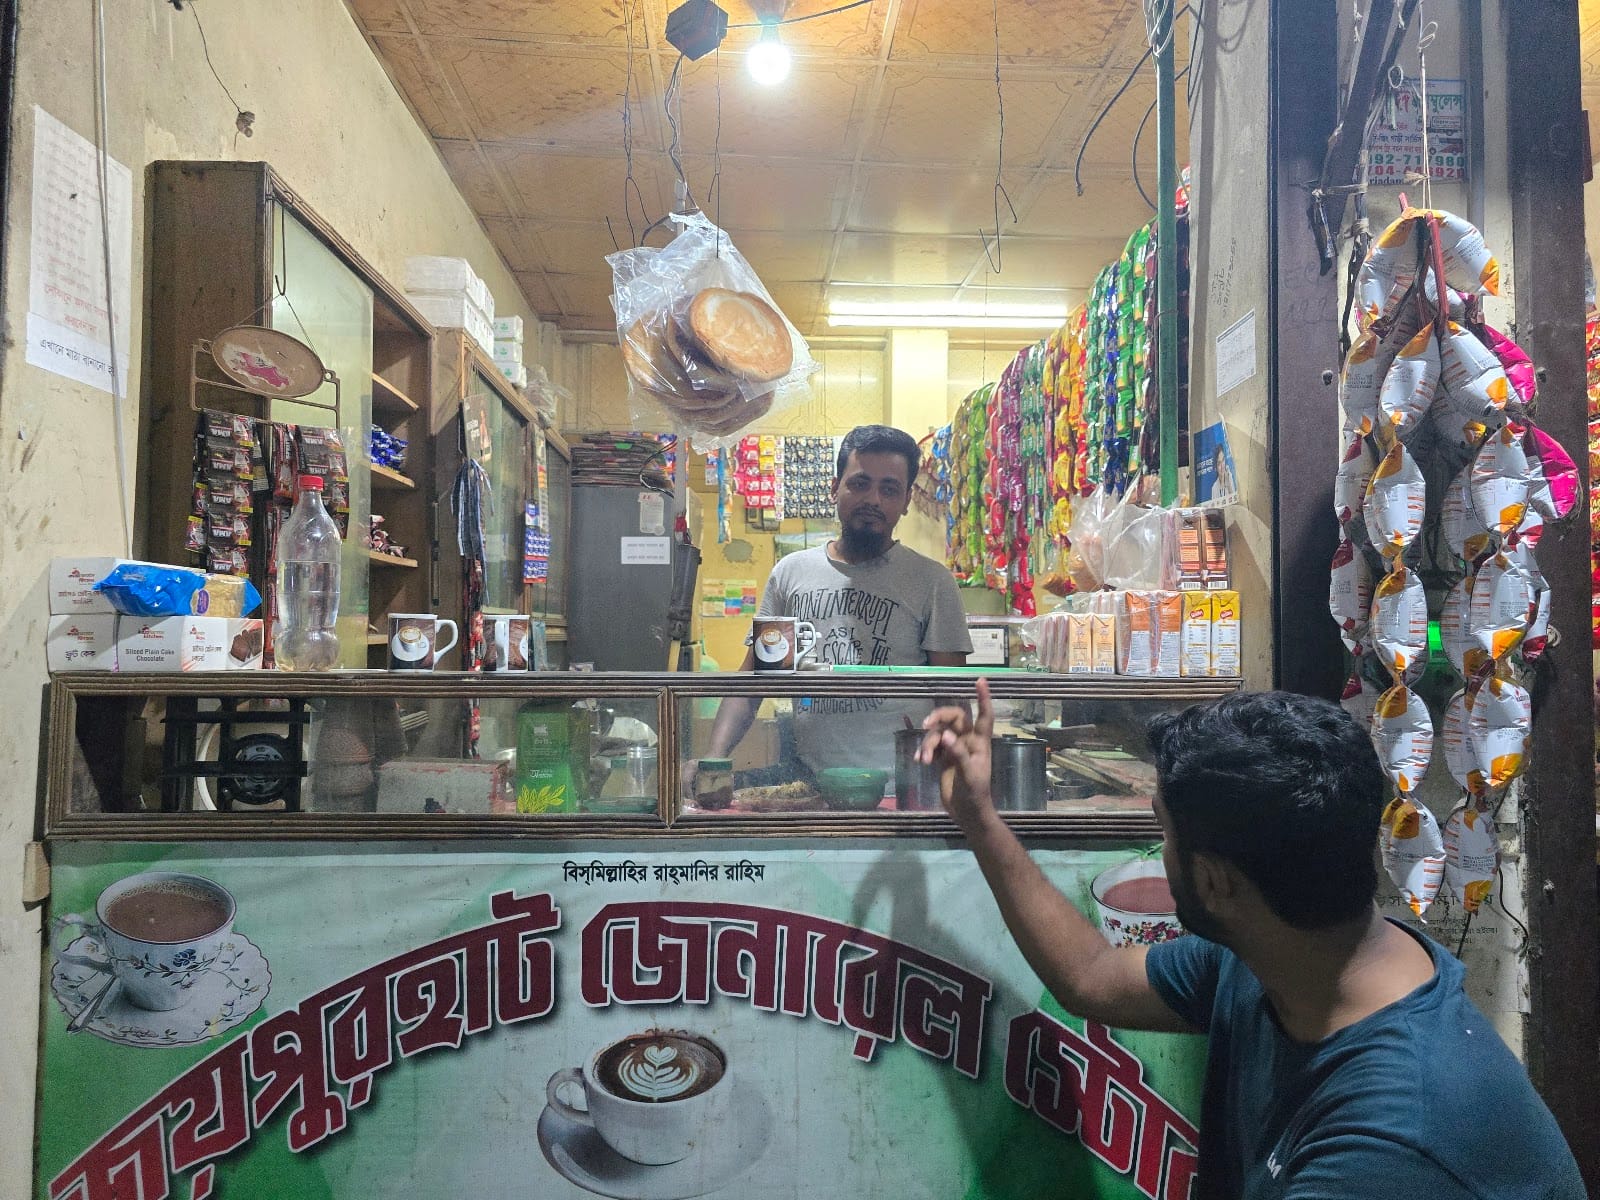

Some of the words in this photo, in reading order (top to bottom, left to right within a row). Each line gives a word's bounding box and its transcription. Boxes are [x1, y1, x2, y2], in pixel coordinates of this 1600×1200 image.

[823, 588, 899, 636] INTERRUPT
[825, 627, 847, 641] AS
[870, 637, 891, 665] THE
[723, 859, 765, 884] রাহিম
[582, 901, 992, 1079] জেনারেল
